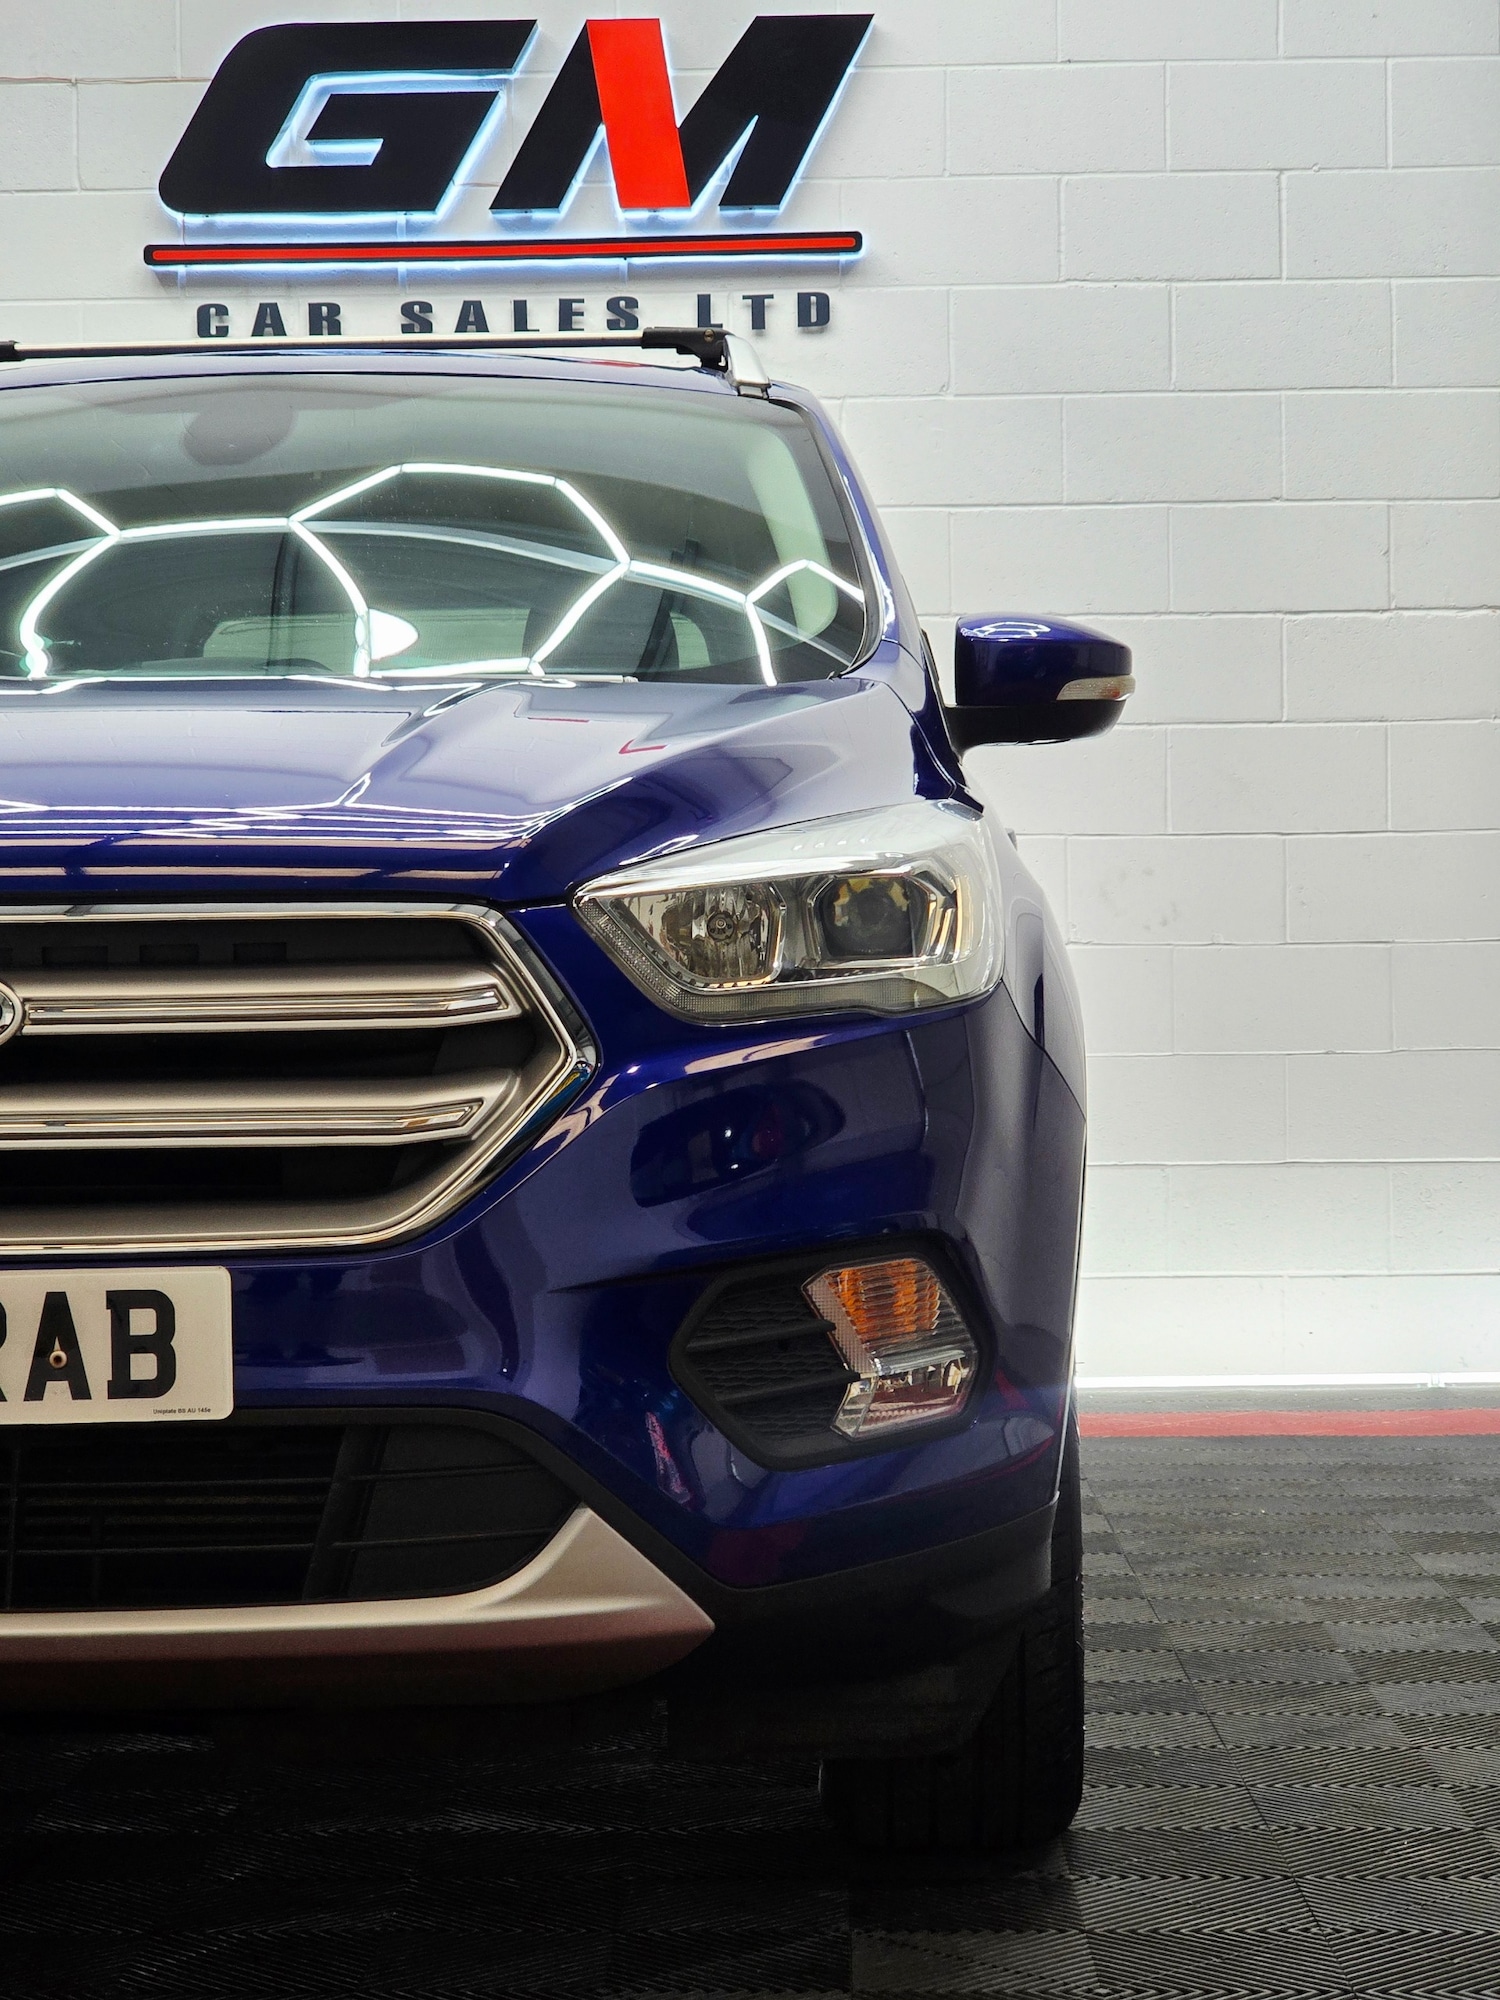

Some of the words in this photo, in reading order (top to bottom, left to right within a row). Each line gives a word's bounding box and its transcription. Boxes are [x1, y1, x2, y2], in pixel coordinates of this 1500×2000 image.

[159, 14, 875, 214] GM
[196, 302, 342, 337] CAR
[400, 296, 639, 334] SALES
[697, 292, 830, 330] LTD
[0, 1289, 177, 1402] AB
